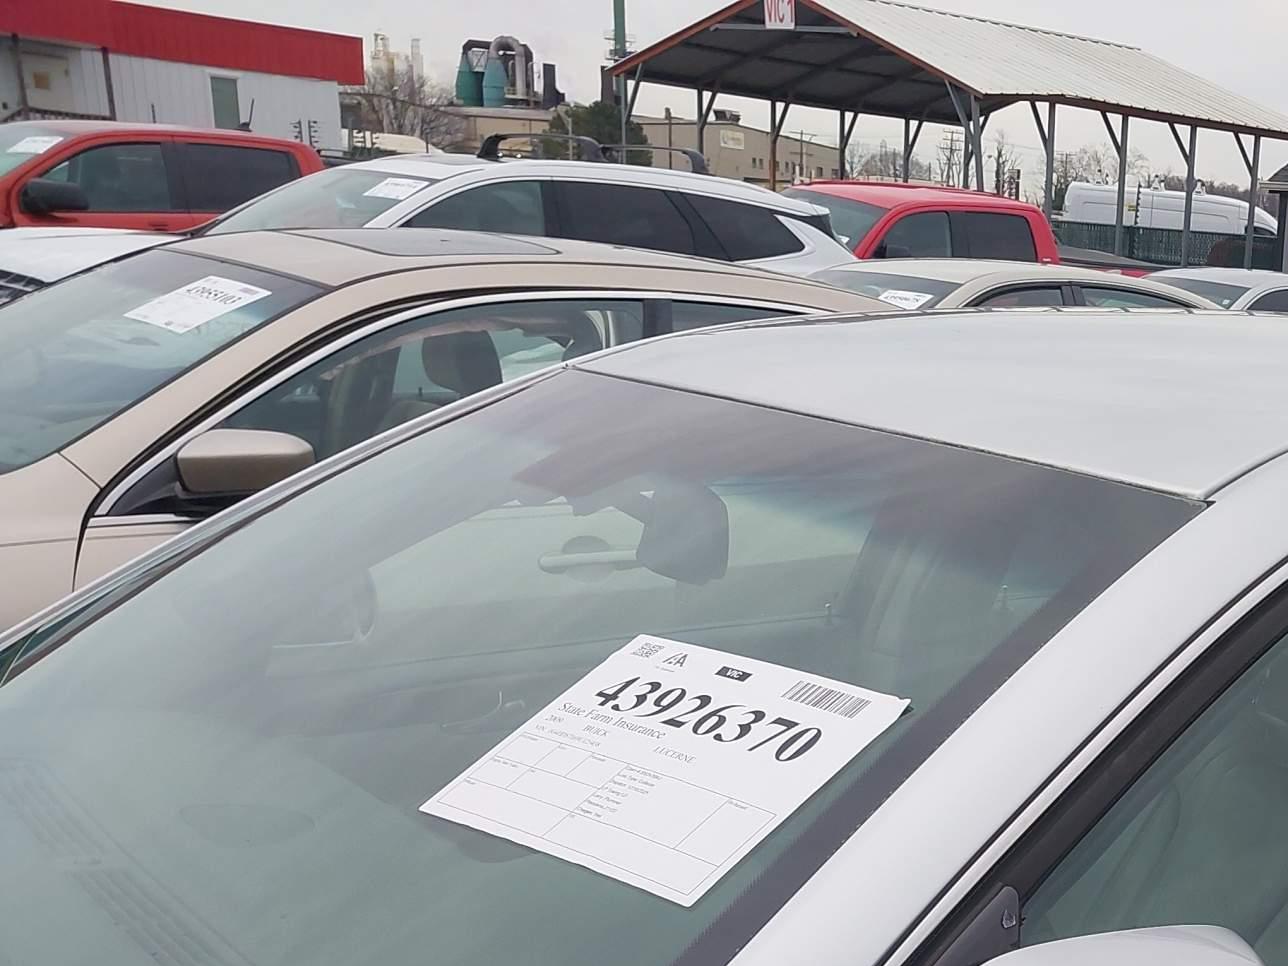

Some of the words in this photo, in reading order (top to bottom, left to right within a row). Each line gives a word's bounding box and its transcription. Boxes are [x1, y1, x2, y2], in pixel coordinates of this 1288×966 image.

[766, 0, 785, 23] VIC
[725, 668, 744, 679] VIC
[558, 702, 586, 717] State
[583, 708, 613, 725] Farm
[613, 716, 667, 740] Insurance
[595, 676, 822, 762] 43926370
[582, 724, 609, 738] BUICK
[653, 745, 697, 764] LUCERNE
